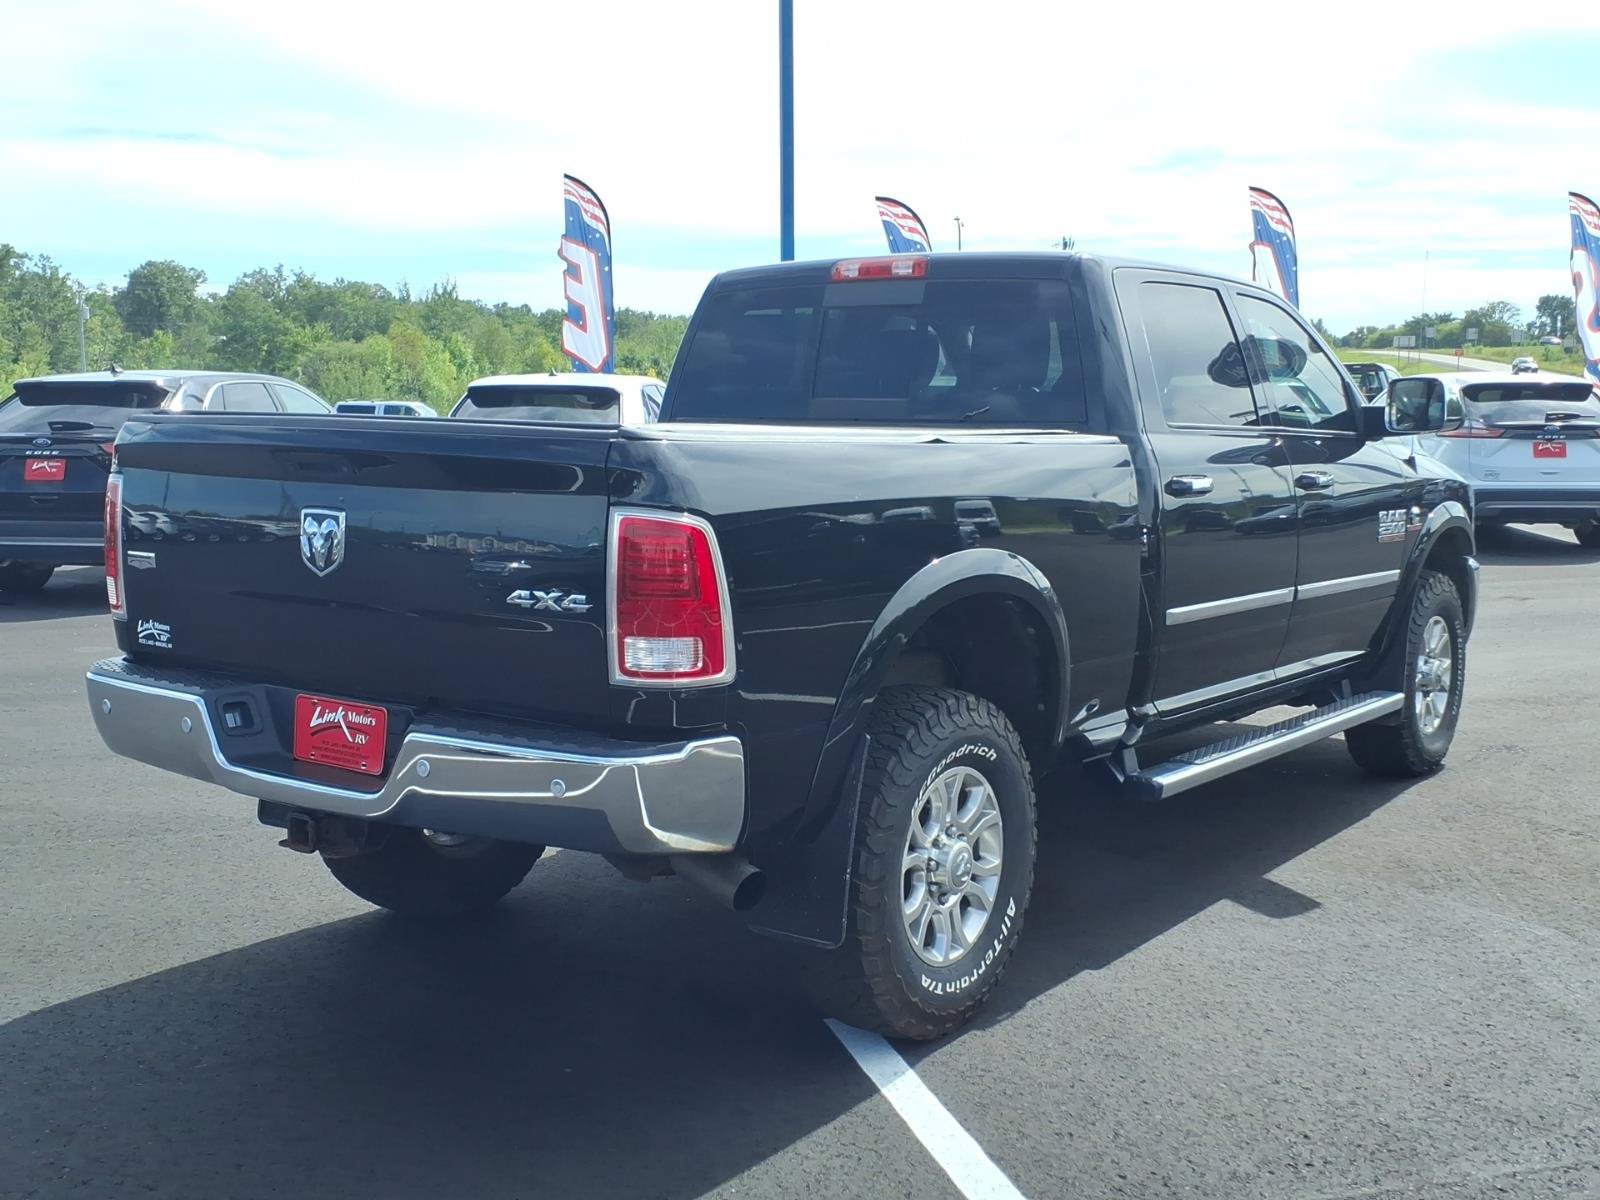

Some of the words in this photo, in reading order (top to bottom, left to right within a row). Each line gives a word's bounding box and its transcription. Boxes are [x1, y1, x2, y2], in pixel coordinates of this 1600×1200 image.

[1378, 509, 1407, 523] RAM
[309, 706, 353, 743] Link
[346, 711, 376, 726] Motors
[355, 733, 369, 744] RV
